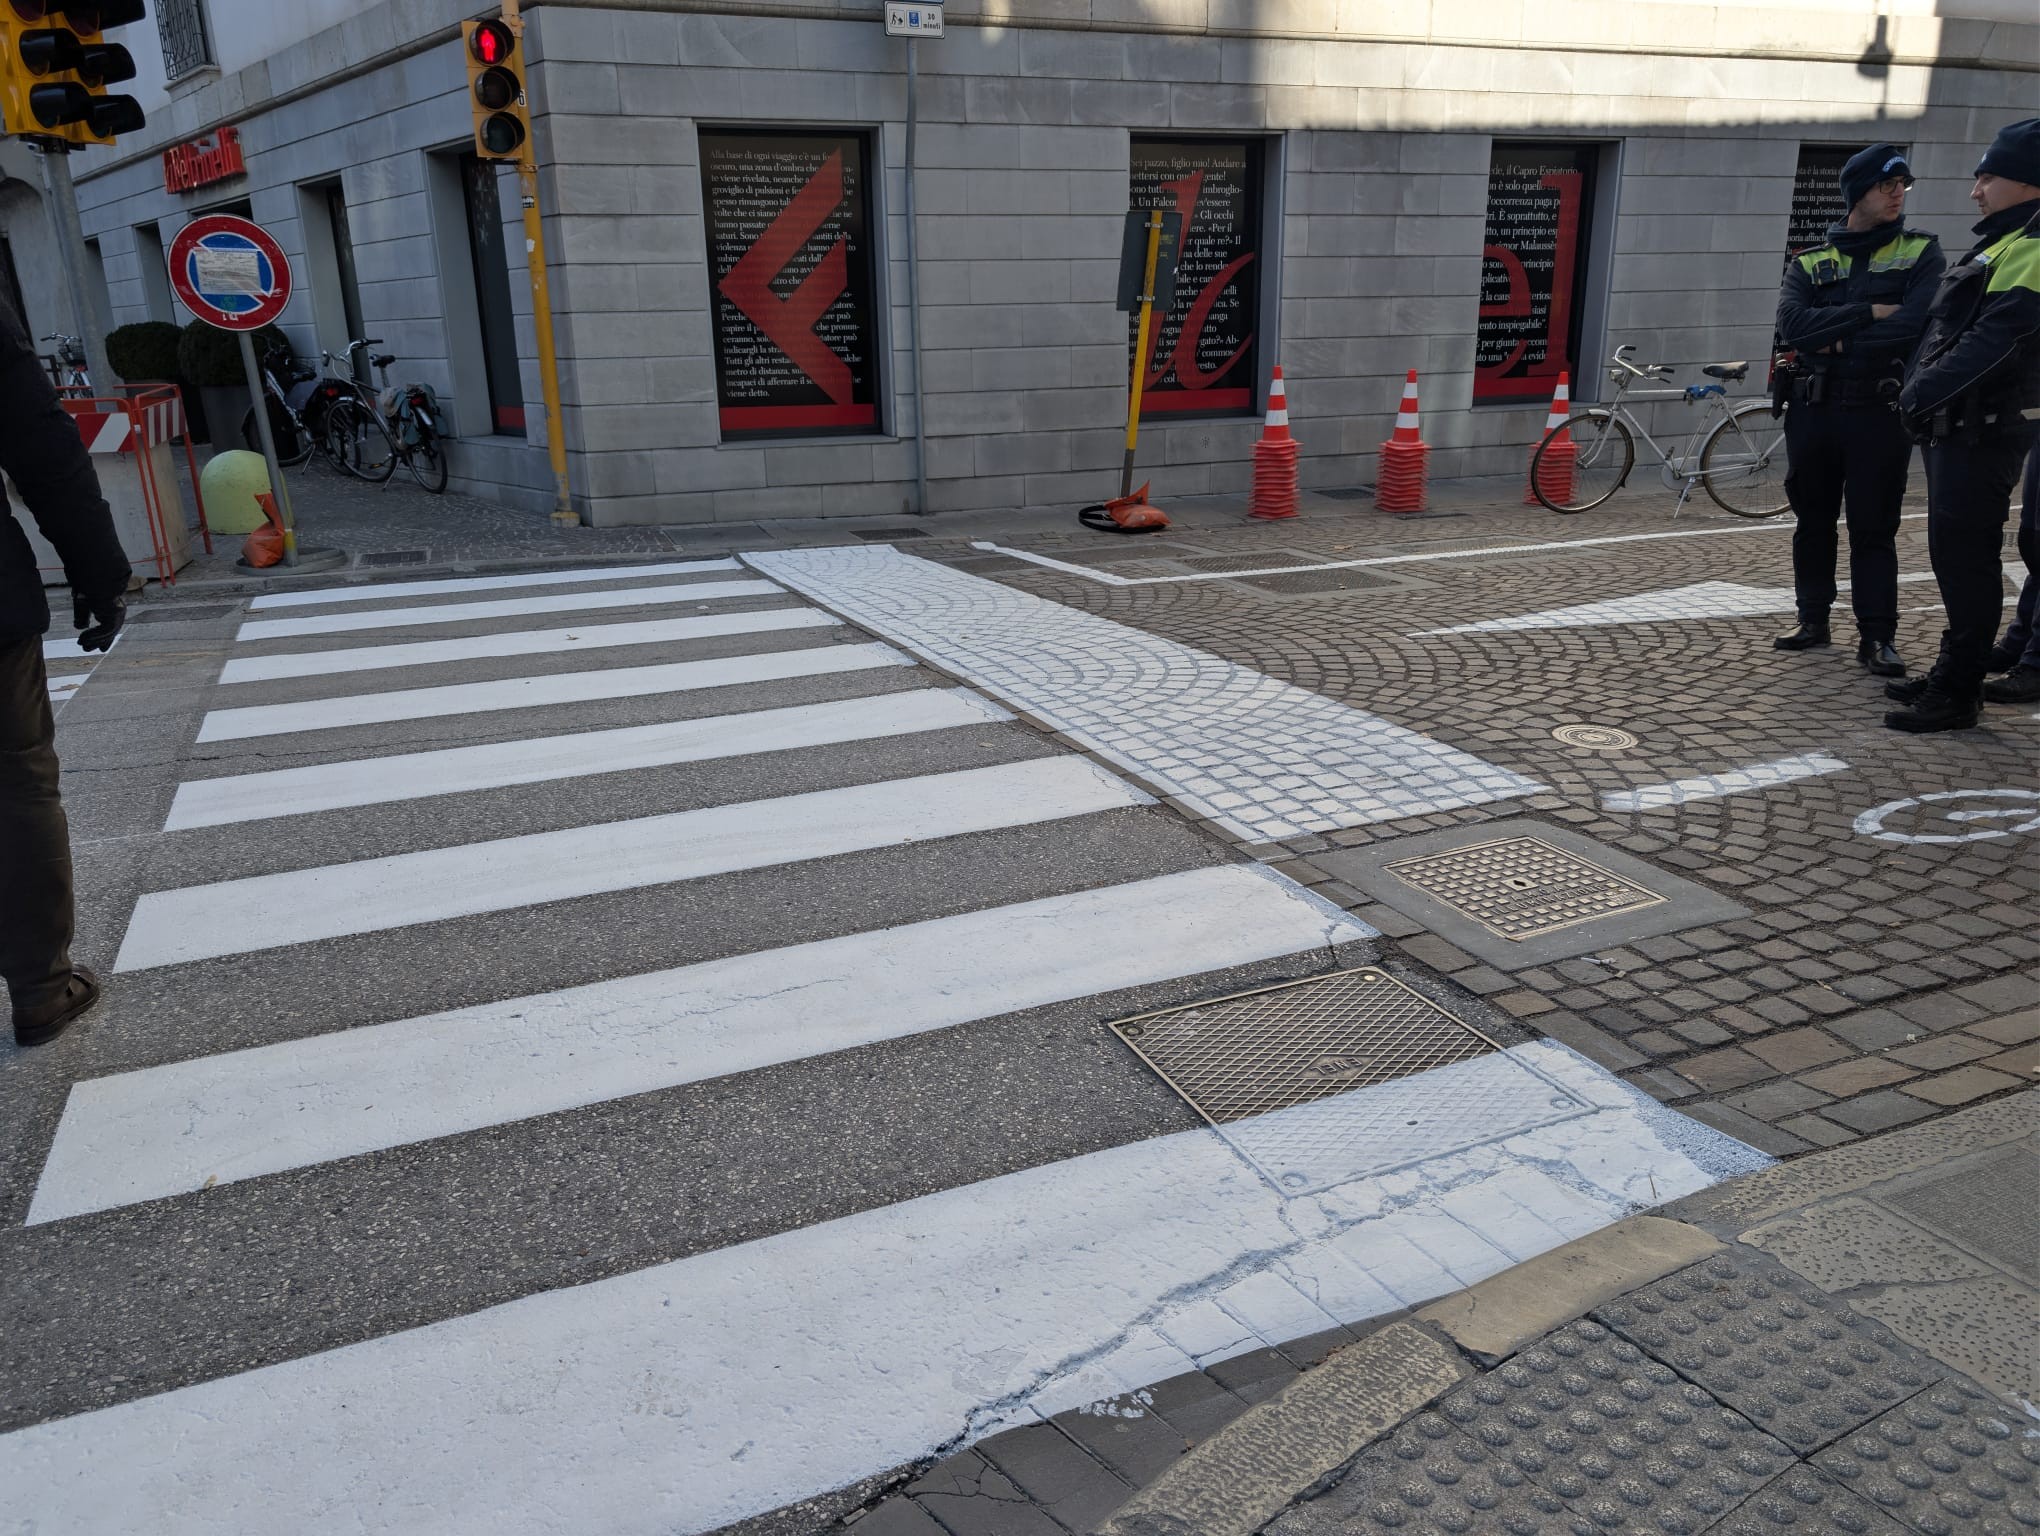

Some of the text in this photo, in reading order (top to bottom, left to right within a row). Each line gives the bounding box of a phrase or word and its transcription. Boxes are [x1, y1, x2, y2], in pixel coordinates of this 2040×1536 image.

[726, 151, 744, 160] base
[744, 151, 752, 160] di
[754, 152, 770, 162] ogni
[771, 152, 798, 162] viaggio
[711, 164, 736, 172] oscuro,
[774, 162, 804, 172] d'ombra
[806, 162, 819, 172] che
[1144, 160, 1169, 170] pazzo,
[1171, 157, 1190, 170] figlio
[1192, 158, 1210, 168] mio!
[1212, 158, 1240, 168] Andare
[1160, 172, 1174, 180] con
[1506, 164, 1512, 176] il
[1513, 165, 1538, 179] Capro
[742, 174, 771, 184] rivelata,
[773, 175, 803, 183] neanche
[844, 176, 855, 184] Un
[1808, 178, 1815, 189] di
[1504, 179, 1521, 190] solo
[712, 186, 744, 196] groviglio
[754, 186, 784, 196] pulsioni
[712, 199, 737, 208] spesso
[738, 198, 779, 208] rimangono
[1138, 197, 1150, 206] Un
[1534, 198, 1553, 209] paga
[714, 208, 732, 217] volte
[734, 208, 748, 217] che
[748, 209, 756, 217] ci
[756, 209, 780, 217] siano
[1200, 210, 1234, 220] Gli occhi
[1798, 206, 1810, 216] così
[1507, 211, 1550, 224] soprattutto,
[714, 219, 766, 231] hanno passate
[1228, 222, 1232, 232] il
[740, 232, 759, 240] Sono
[1512, 226, 1547, 239] principio
[716, 243, 747, 251] violenza
[1194, 236, 1216, 248] quale
[1194, 248, 1213, 258] delle
[1180, 260, 1204, 270] che lo
[1176, 286, 1198, 296] anche
[1486, 290, 1492, 301] la
[1178, 298, 1184, 308] la
[1230, 298, 1240, 308] Se
[722, 325, 745, 334] capire
[746, 324, 752, 332] il
[816, 323, 830, 331] che
[722, 336, 755, 344] ceranno,
[843, 334, 857, 342] può
[1481, 340, 1496, 351] per
[724, 346, 758, 356] indicargli
[725, 356, 742, 365] Tutti
[756, 356, 770, 365] altri
[749, 367, 757, 375] di
[758, 367, 790, 376] distanza,
[726, 378, 756, 388] incapaci
[758, 378, 766, 386] di
[766, 376, 799, 386] afferrare
[800, 376, 805, 385] il
[726, 388, 770, 398] viene detto.
[1311, 1055, 1364, 1076] ENEL
